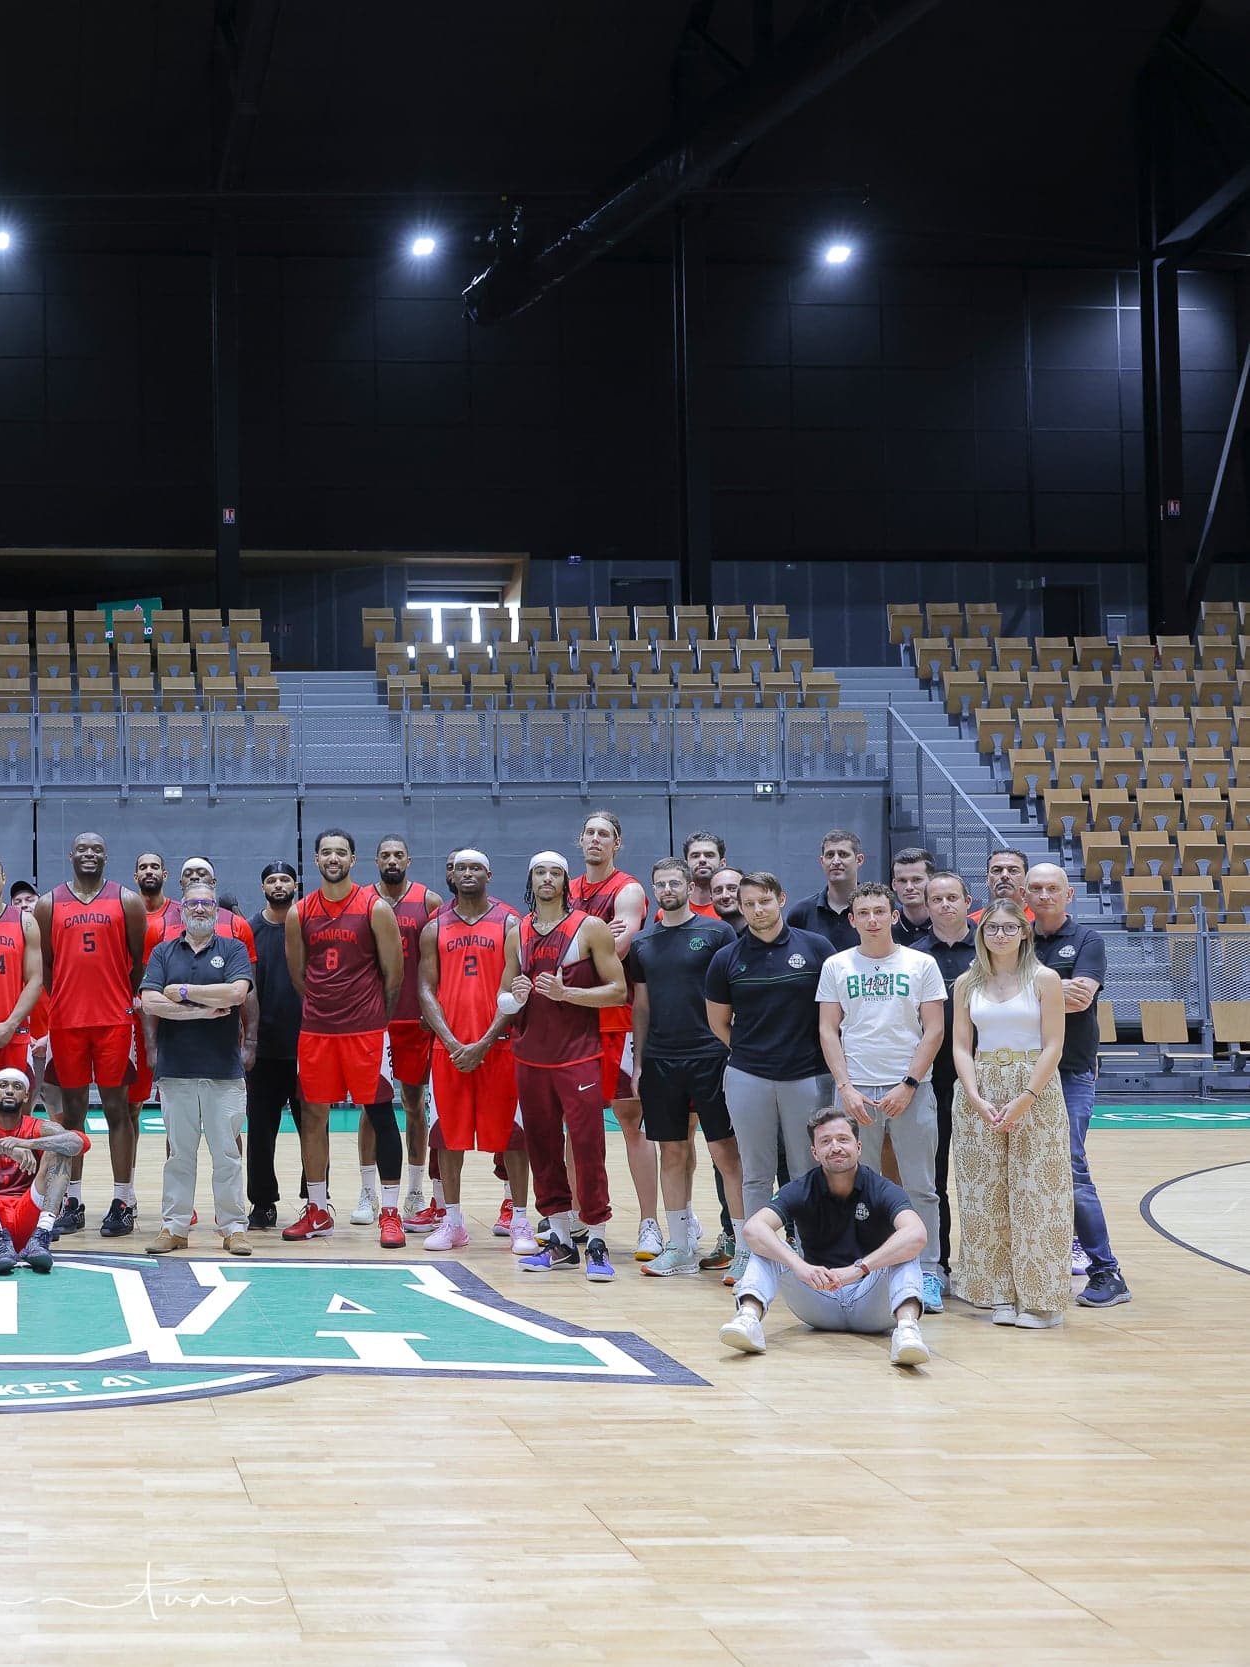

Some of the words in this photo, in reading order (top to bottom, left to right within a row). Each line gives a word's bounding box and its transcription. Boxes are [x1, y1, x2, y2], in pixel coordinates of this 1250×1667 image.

[64, 912, 112, 929] CANADA
[83, 932, 96, 952] 5
[310, 929, 358, 944] CANADA
[447, 935, 496, 952] CANADA
[325, 947, 339, 970] 8
[464, 955, 478, 976] 2
[846, 973, 910, 999] BLOIS
[100, 1373, 151, 1389] 41
